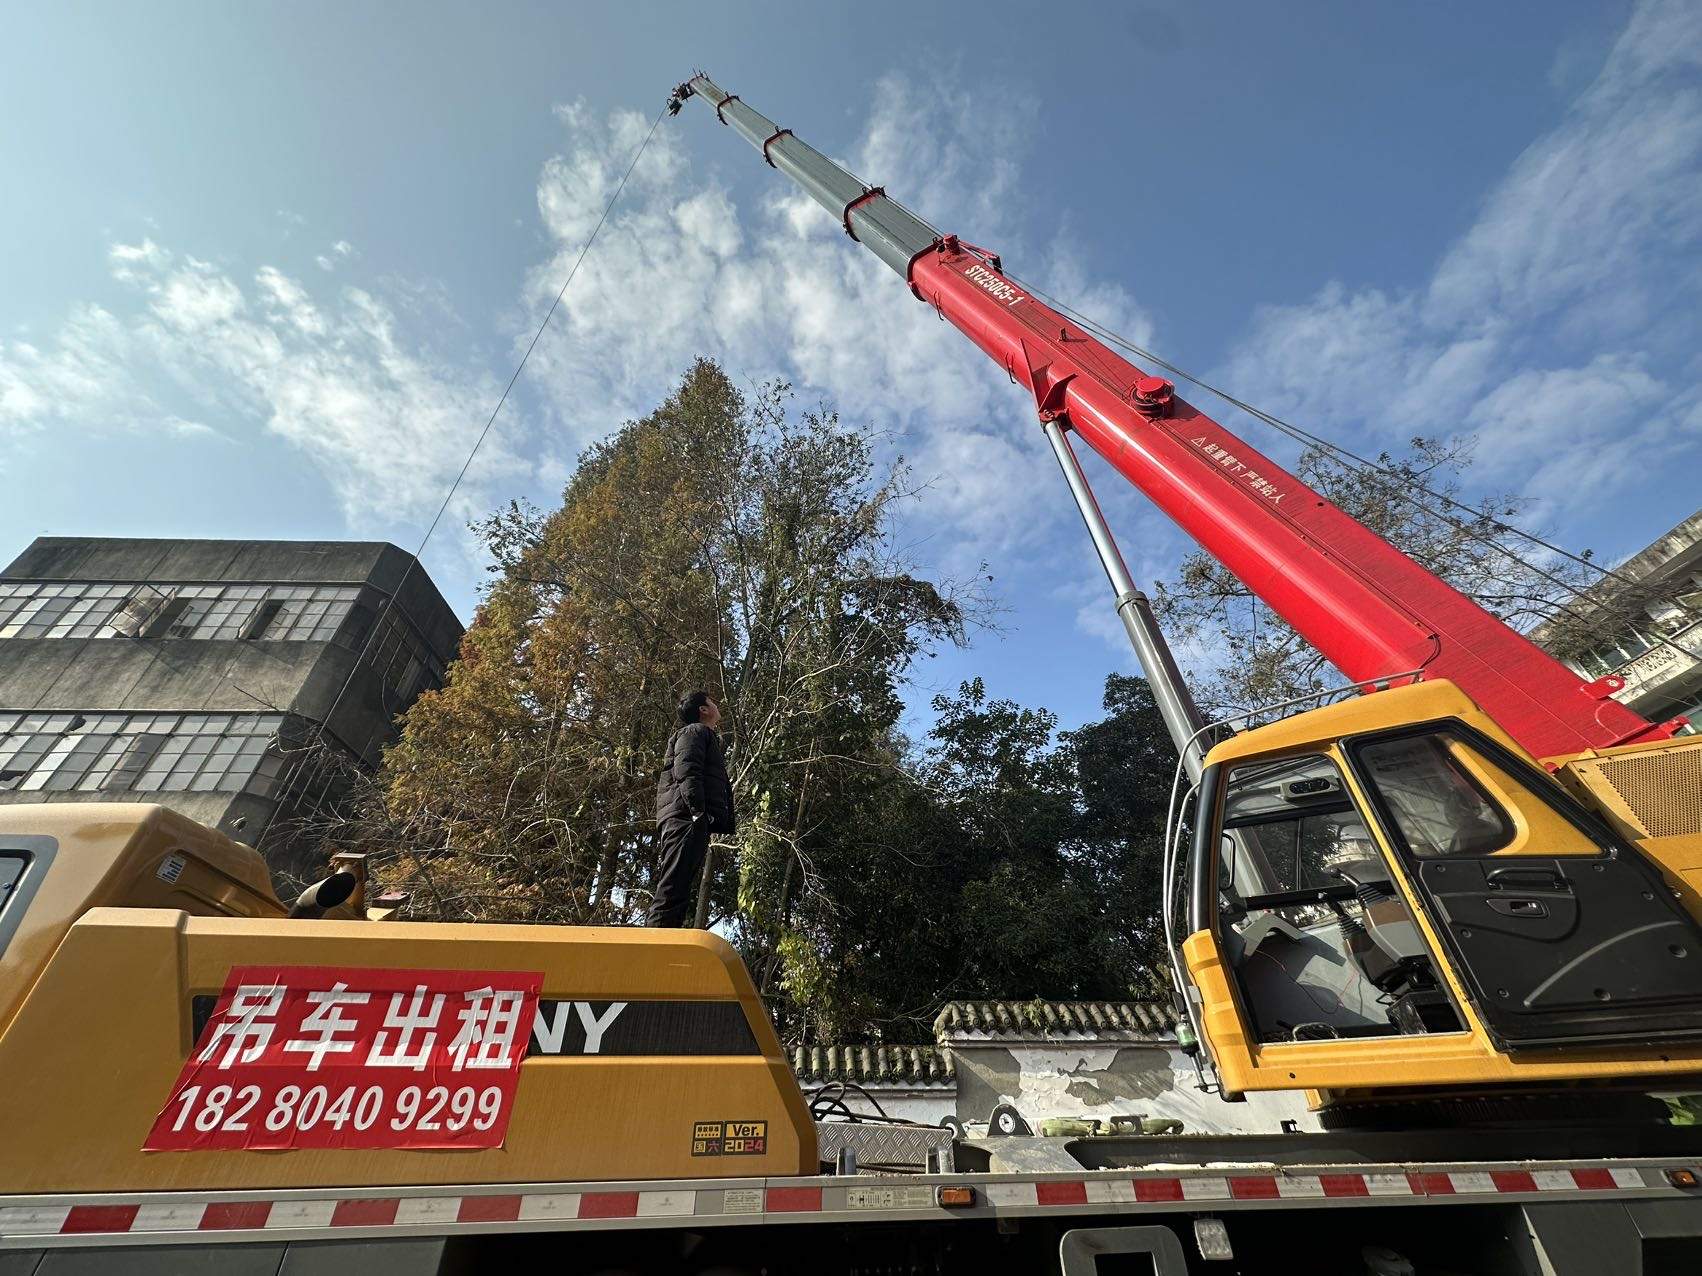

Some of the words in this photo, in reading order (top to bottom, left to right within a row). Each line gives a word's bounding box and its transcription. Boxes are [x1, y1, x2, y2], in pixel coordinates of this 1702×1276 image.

[965, 264, 1025, 306] STC250C5-1
[196, 982, 525, 1072] 吊车出租
[171, 1084, 262, 1132] 182
[265, 1085, 384, 1132] 8040
[390, 1085, 502, 1131] 9299
[724, 1139, 765, 1153] 2024
[732, 1124, 760, 1137] Ver.
